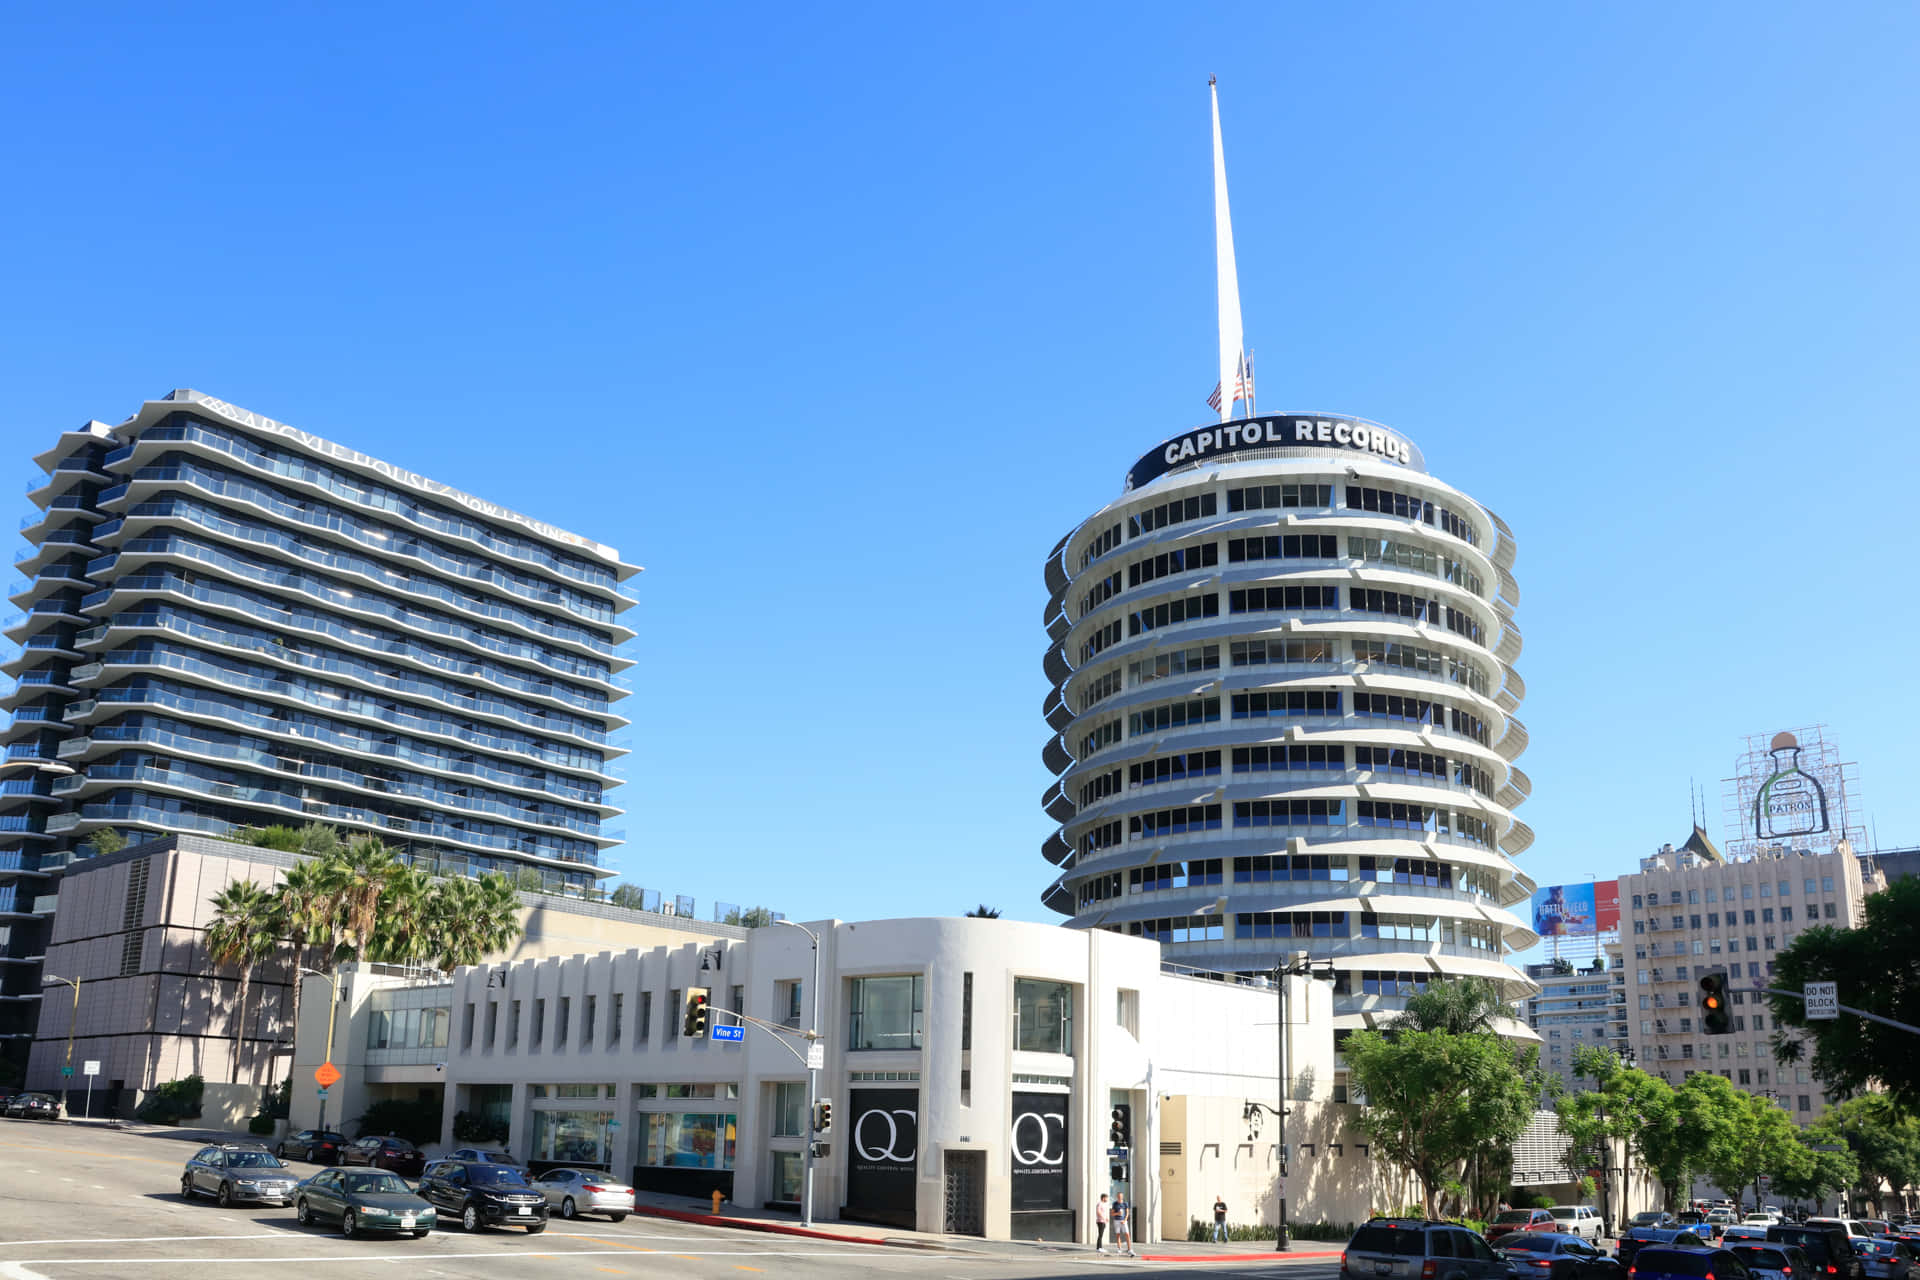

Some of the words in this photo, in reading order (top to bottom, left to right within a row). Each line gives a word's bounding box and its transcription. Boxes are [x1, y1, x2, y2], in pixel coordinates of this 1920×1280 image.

[1164, 420, 1282, 465] CAPITOL
[1295, 420, 1411, 464] RECORDS
[455, 493, 497, 515] NOW
[1806, 987, 1817, 996] DO
[1819, 986, 1834, 996] NOT
[1808, 998, 1835, 1008] BLOCK
[716, 1028, 731, 1038] Vine
[733, 1029, 742, 1038] St
[854, 1108, 917, 1163] QC
[1011, 1112, 1064, 1165] QC
